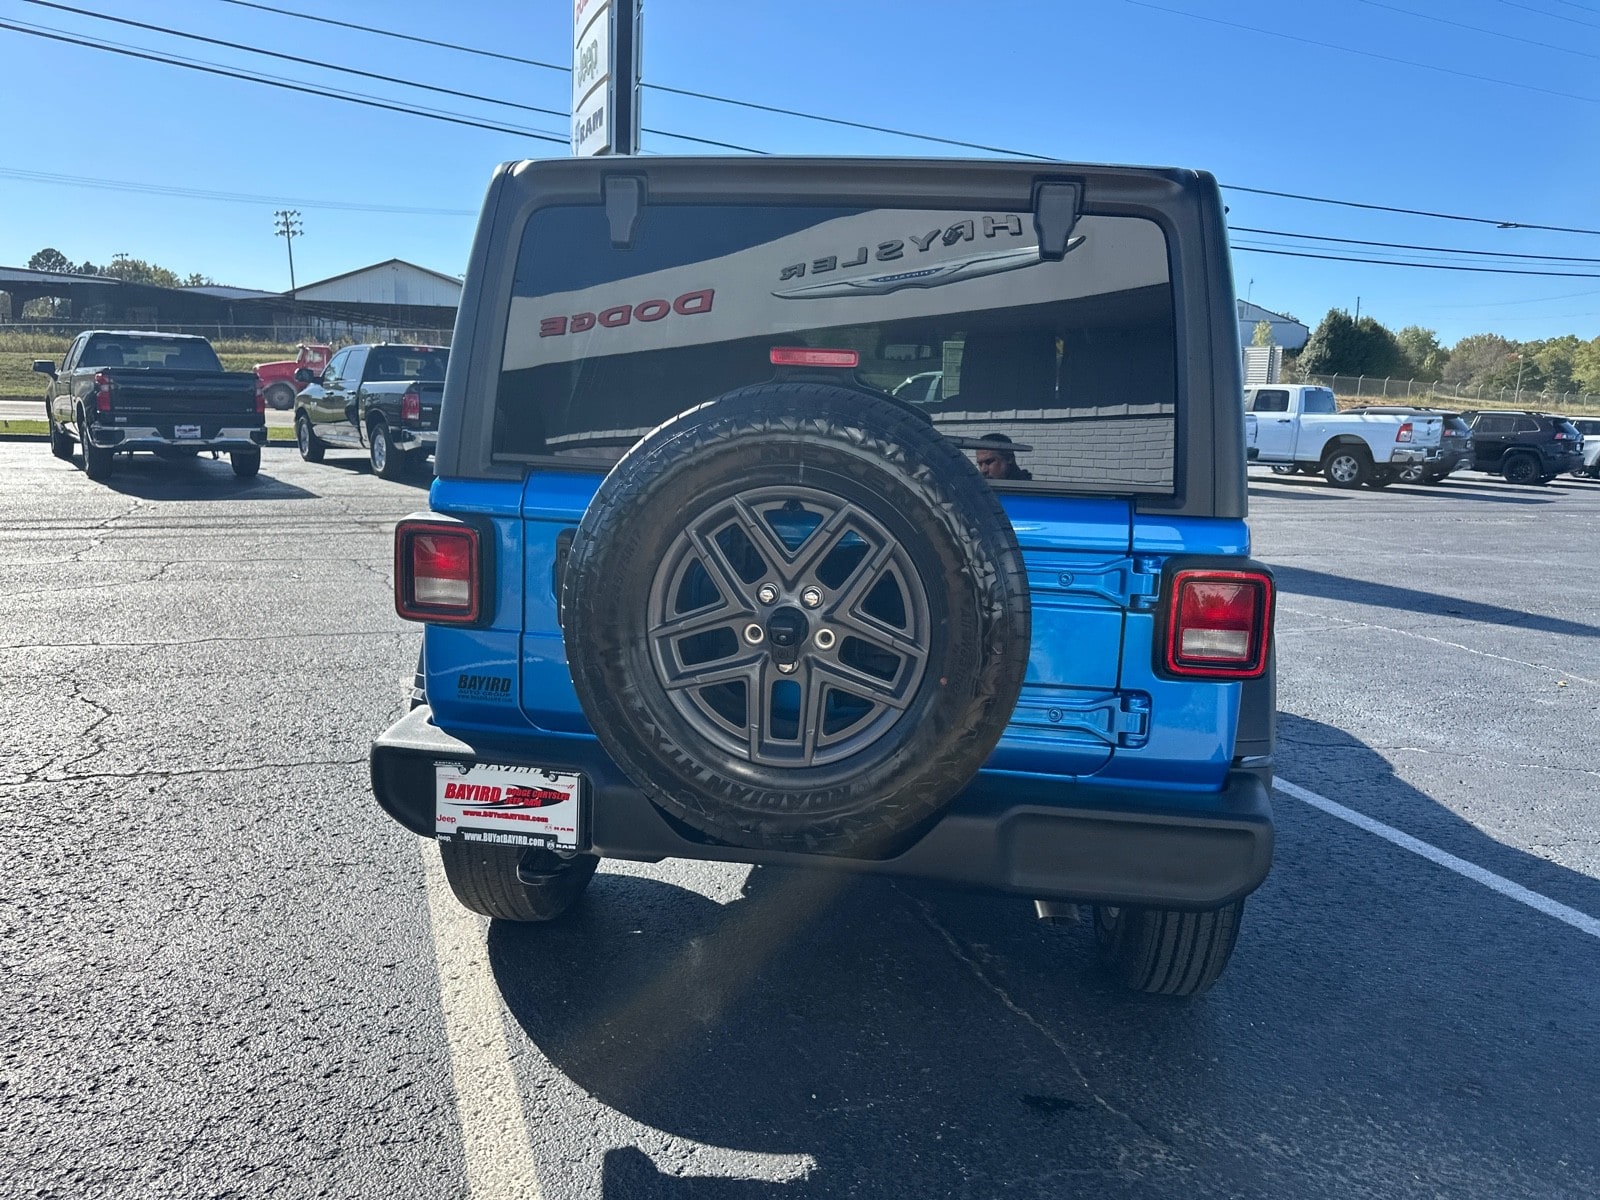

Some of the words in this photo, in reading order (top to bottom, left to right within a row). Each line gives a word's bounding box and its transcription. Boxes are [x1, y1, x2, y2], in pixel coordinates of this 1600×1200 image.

[577, 39, 599, 88] Jeep
[579, 106, 604, 144] RAM
[457, 674, 512, 692] BAYIRD
[474, 763, 542, 774] BAYIRD
[444, 782, 502, 803] BAYIRD
[505, 787, 532, 797] DODGE
[532, 789, 571, 801] CHRYSLER
[436, 814, 457, 824] Jeep
[434, 833, 452, 842] Jeep
[464, 832, 545, 847] www.BUYatBAYIRD.com
